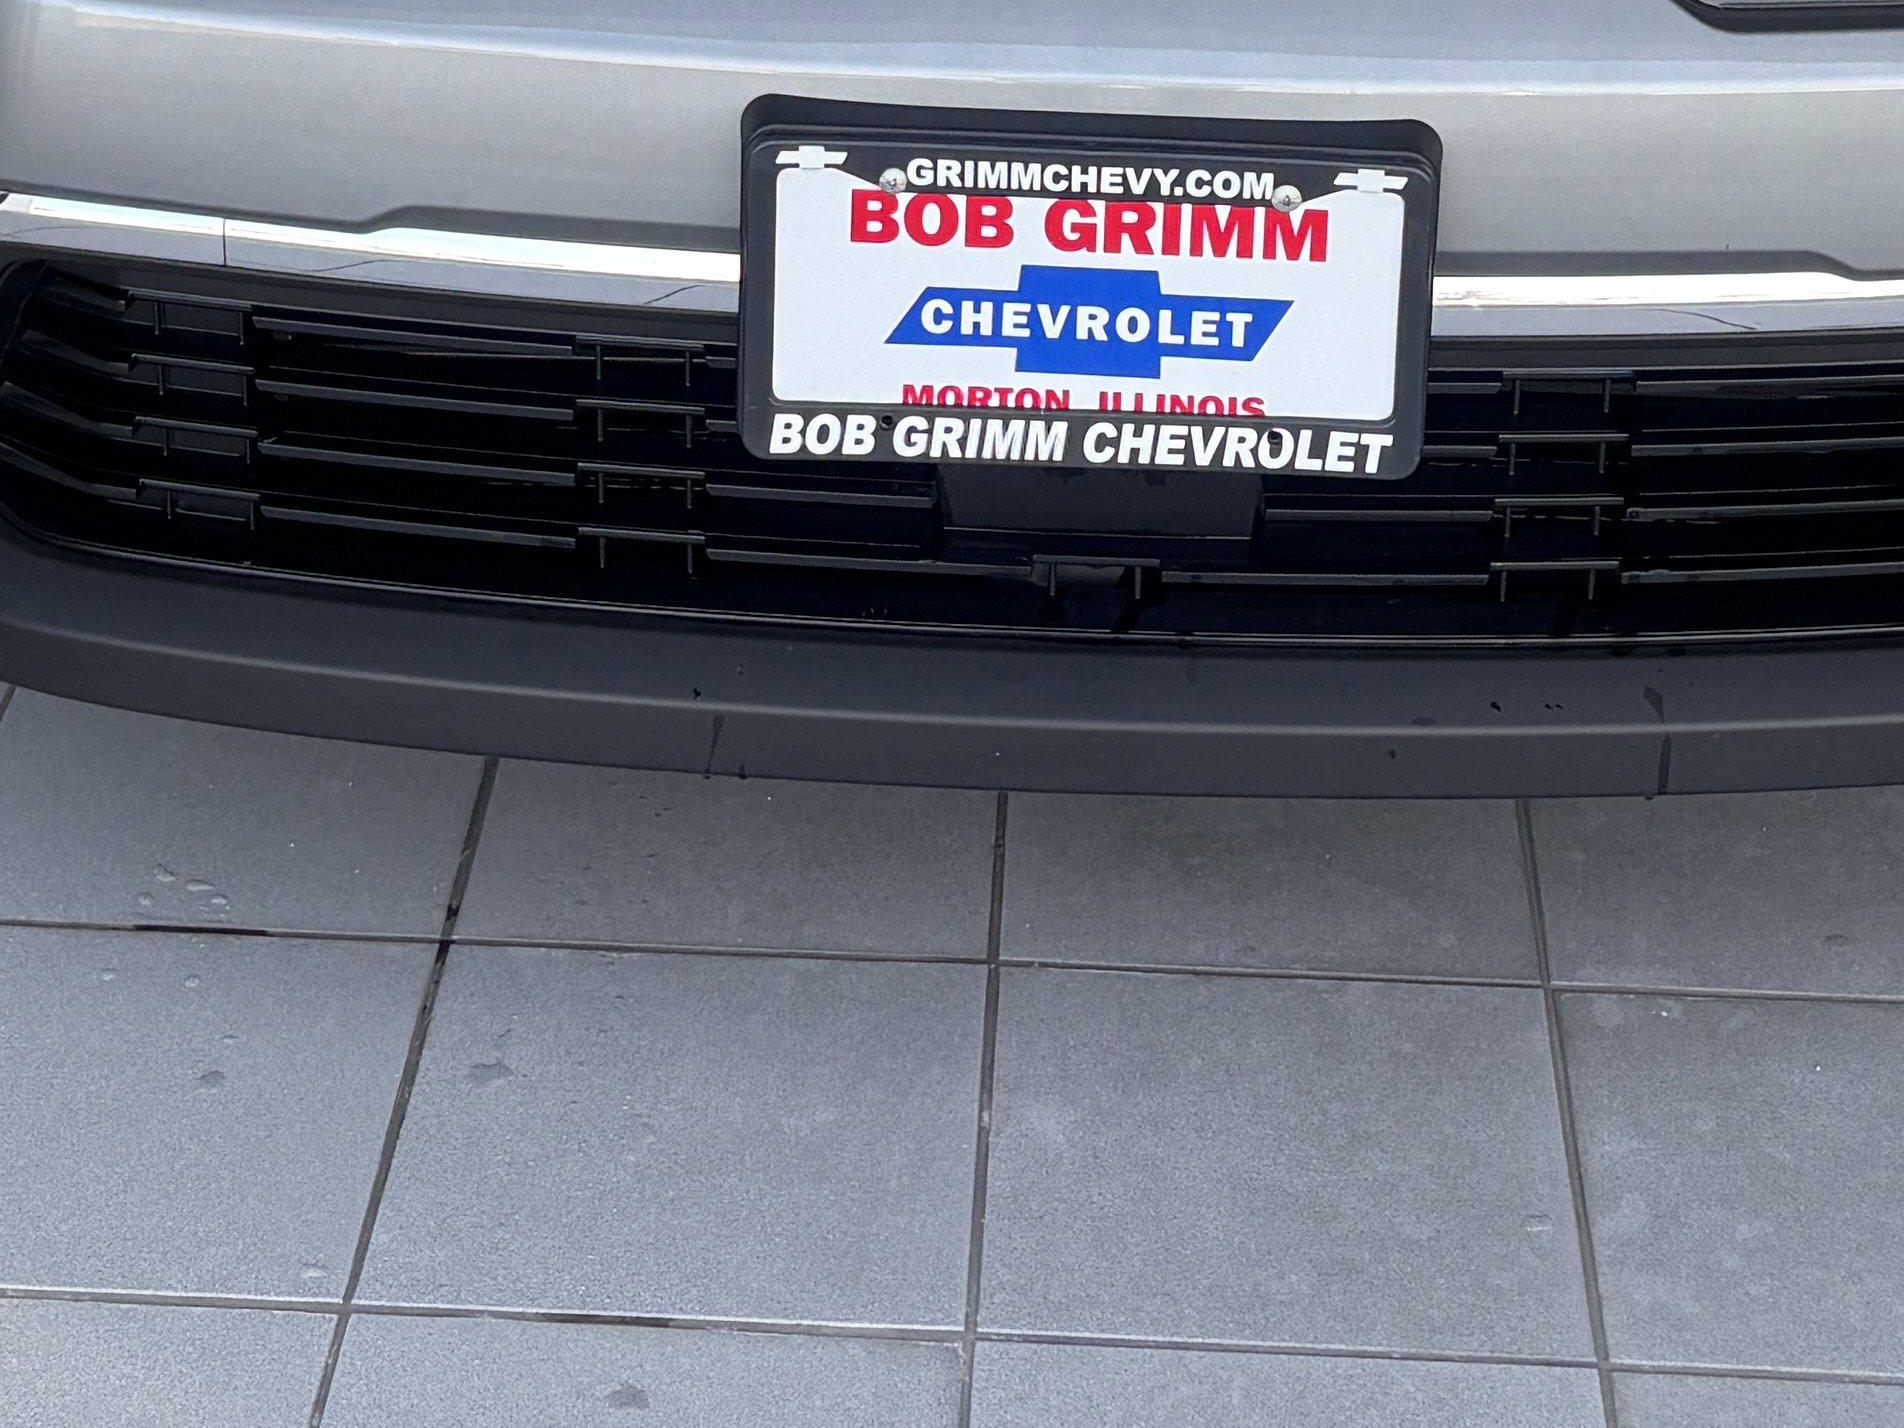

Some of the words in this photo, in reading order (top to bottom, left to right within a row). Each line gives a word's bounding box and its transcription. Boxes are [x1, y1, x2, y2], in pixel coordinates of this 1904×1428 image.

[905, 158, 1275, 200] GRIMMCHEVY.COM
[850, 190, 1014, 247] BOB
[1044, 199, 1330, 263] GRIMM
[920, 298, 1255, 348] CHEVROLET
[769, 414, 877, 456] BOB
[893, 415, 1067, 462] GRIMM
[1083, 422, 1394, 476] CHEVROLET
